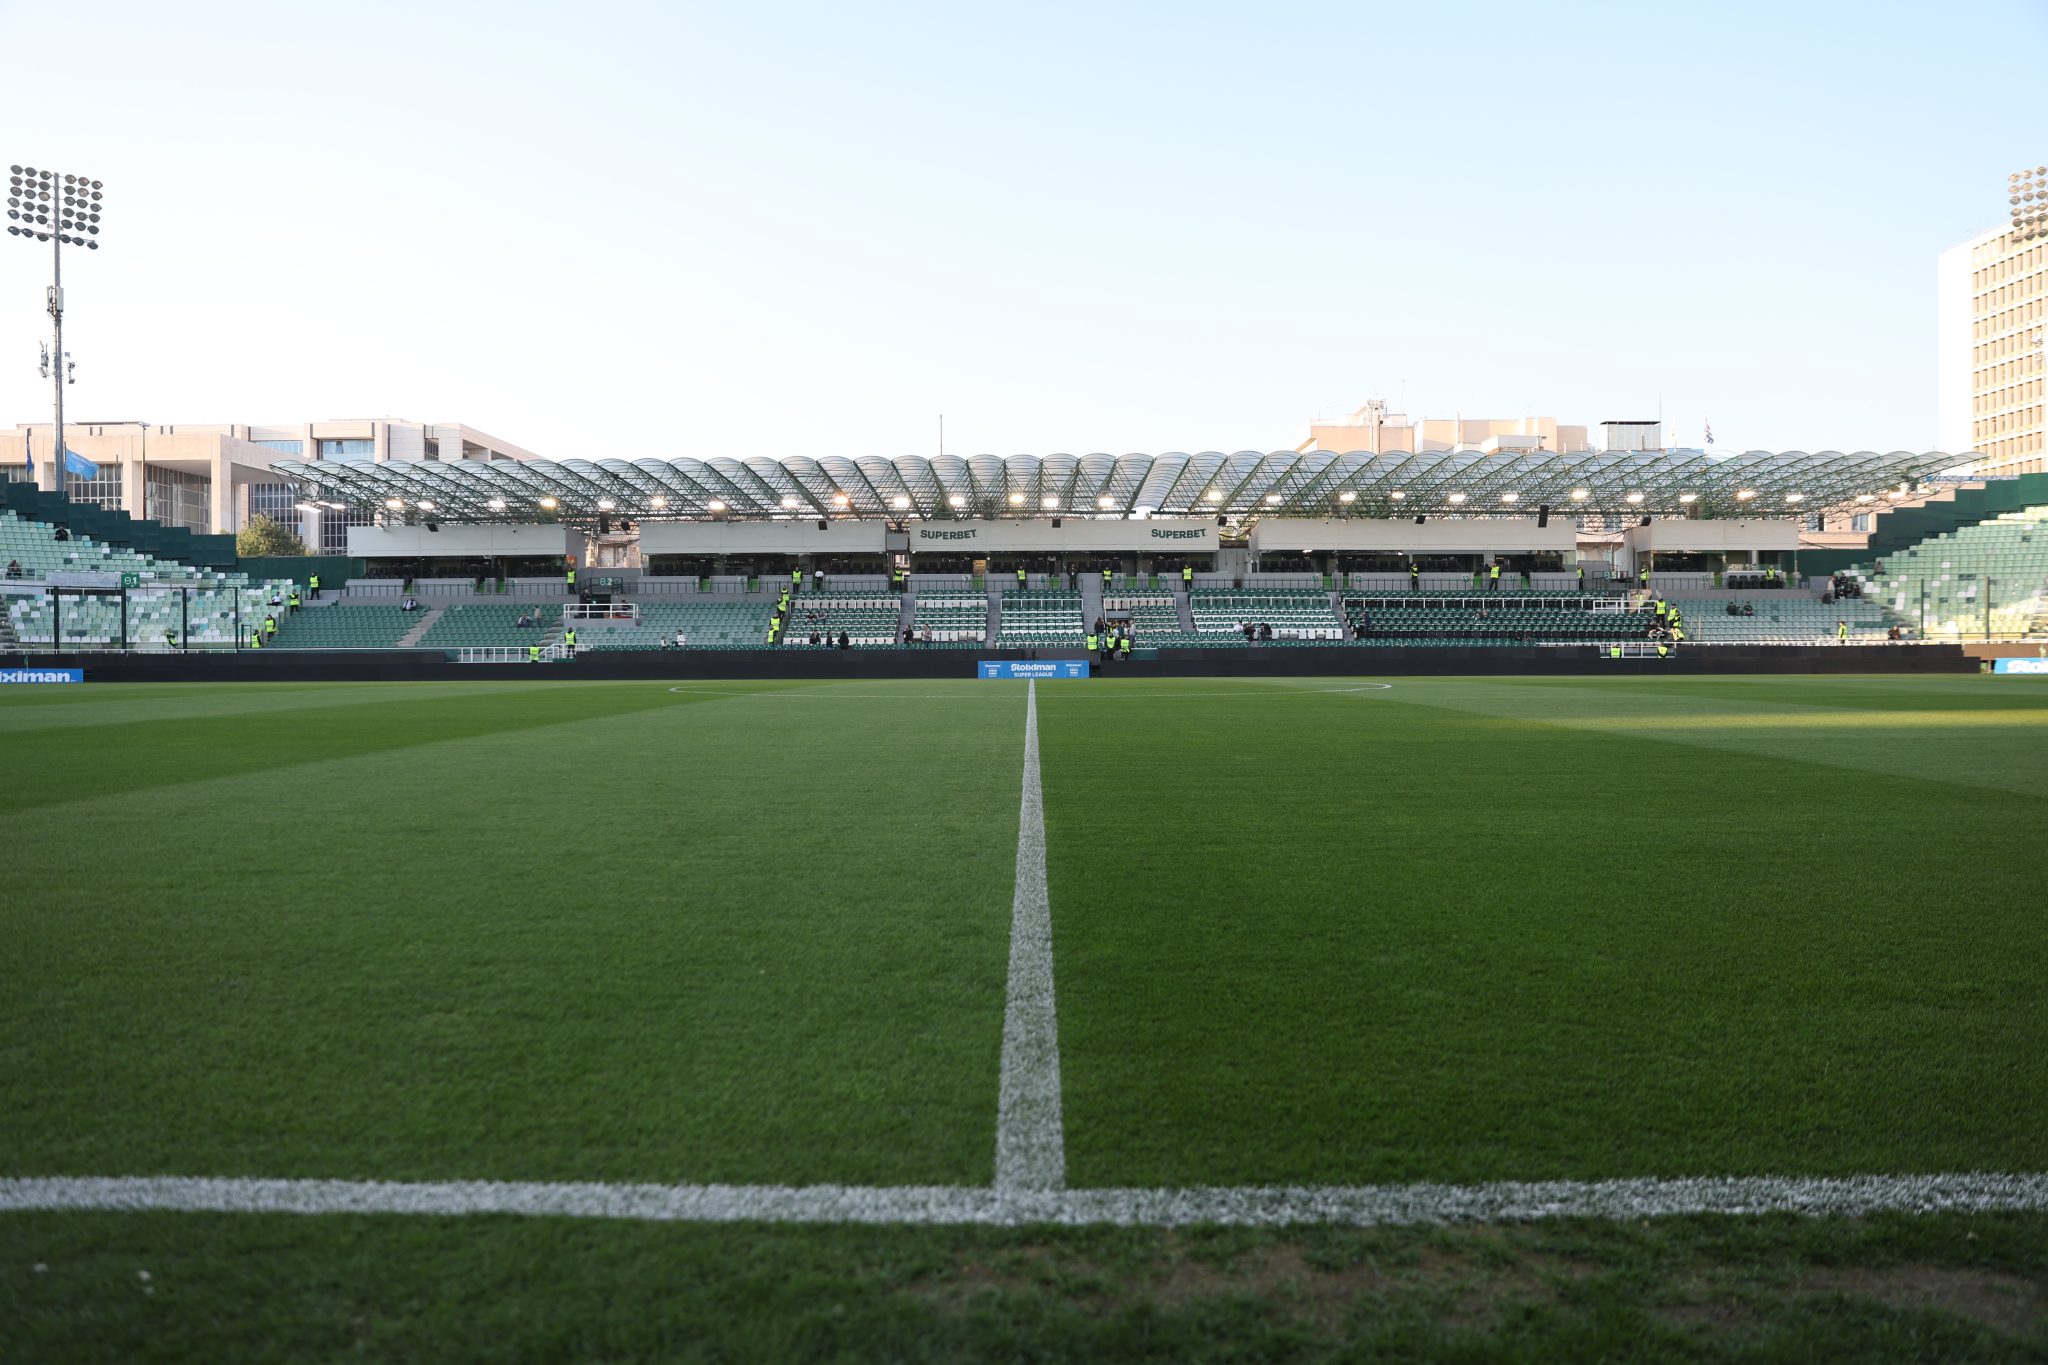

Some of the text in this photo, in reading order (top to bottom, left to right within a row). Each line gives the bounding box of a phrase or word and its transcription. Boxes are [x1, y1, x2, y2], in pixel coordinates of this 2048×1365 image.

[920, 529, 976, 540] SUPERBET
[1151, 528, 1206, 539] SUPERBET
[1011, 663, 1056, 671] Stoiximan
